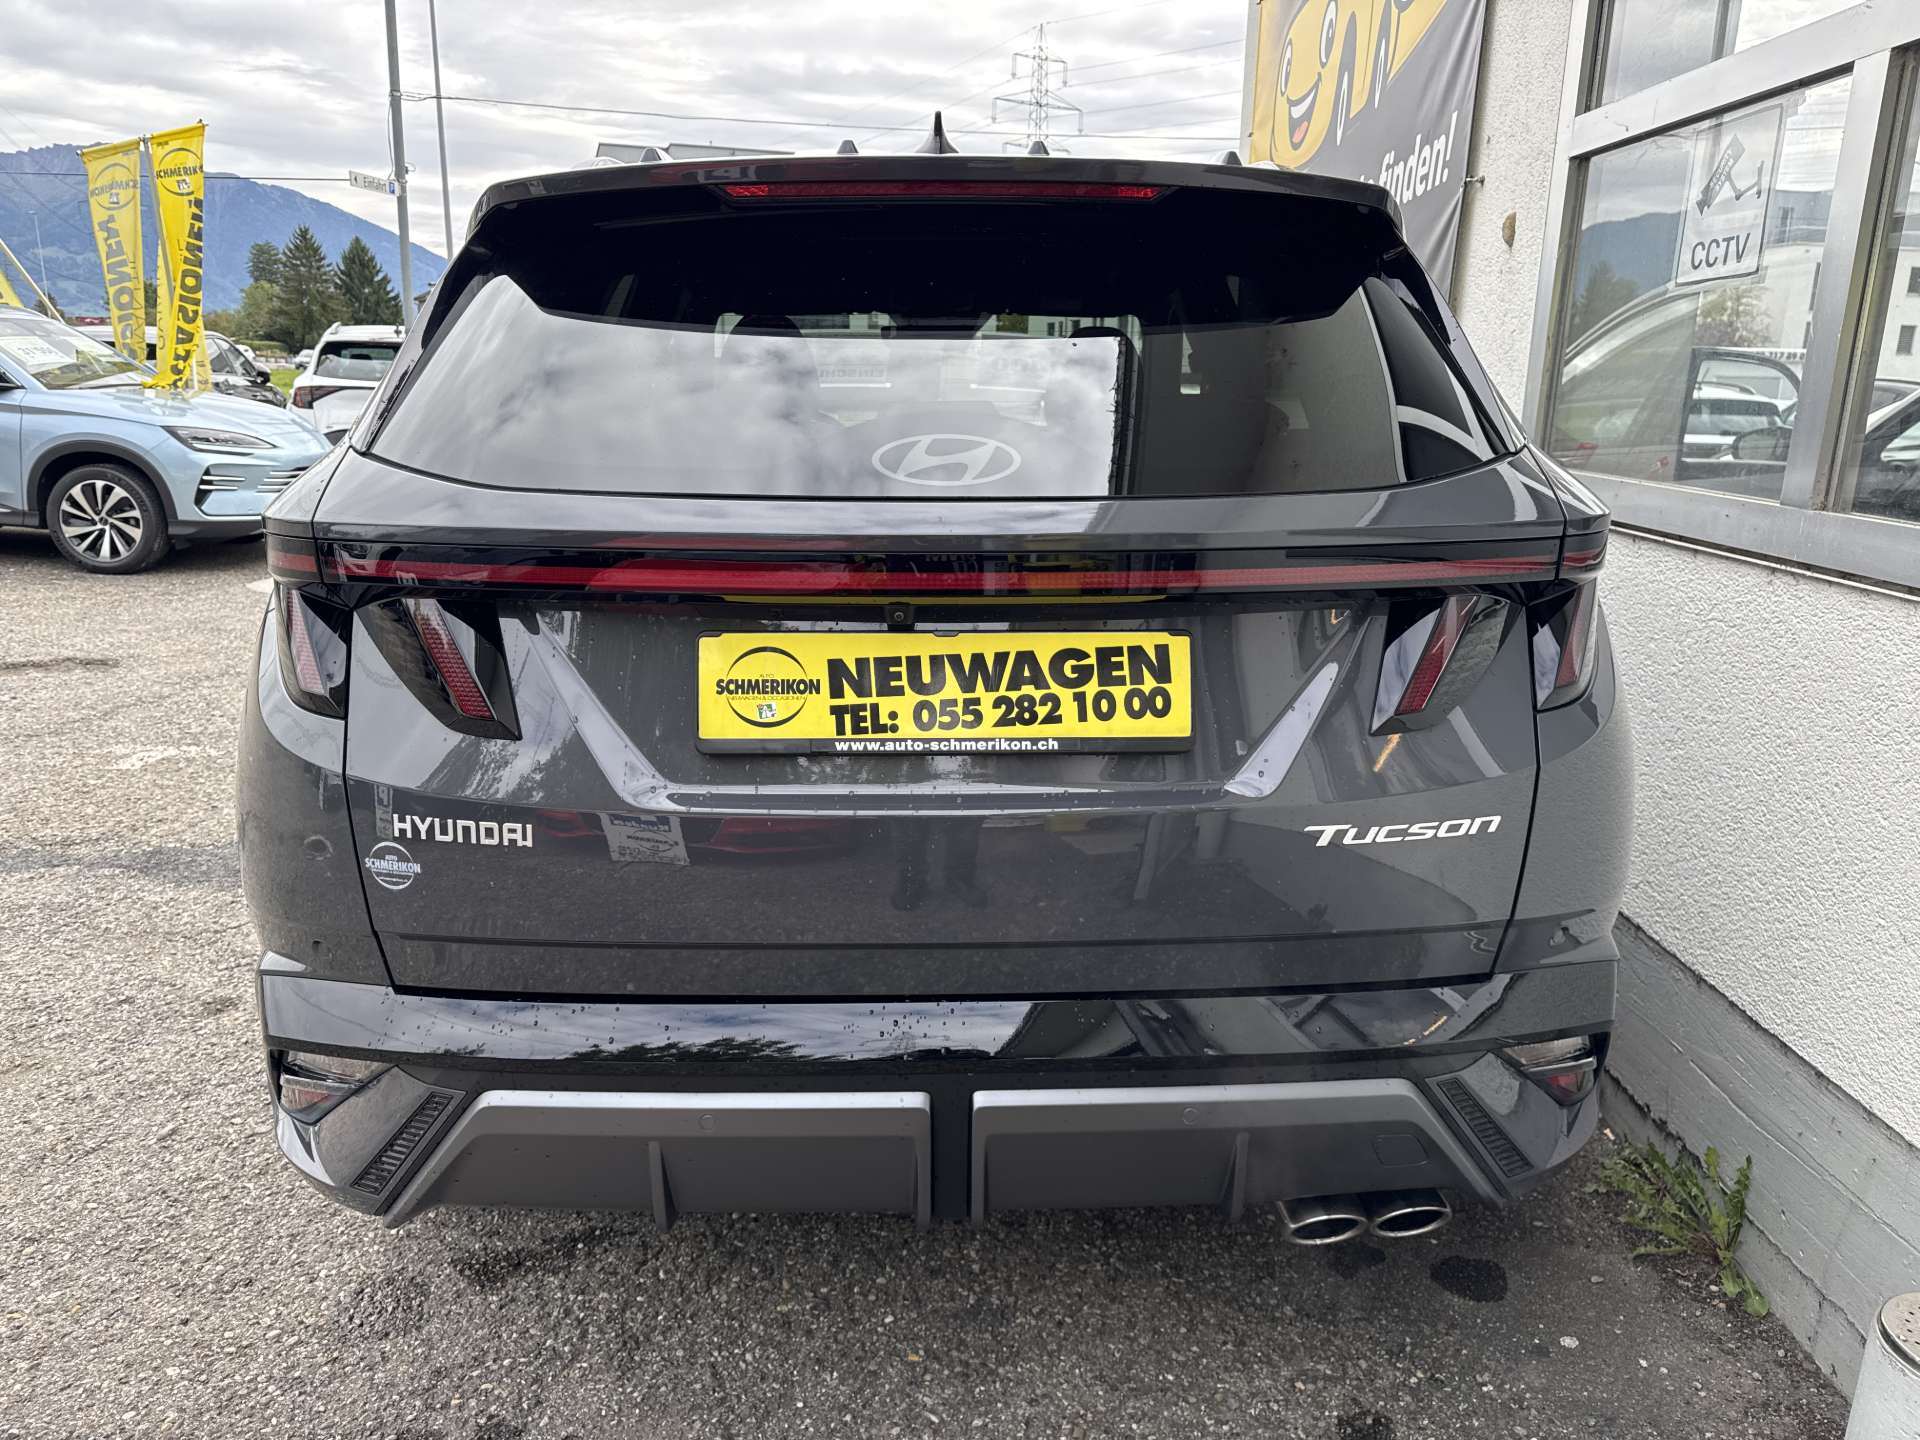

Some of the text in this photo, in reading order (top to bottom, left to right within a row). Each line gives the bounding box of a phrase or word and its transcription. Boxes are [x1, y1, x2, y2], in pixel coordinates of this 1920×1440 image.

[1379, 110, 1458, 205] finden!
[1690, 232, 1751, 270] CCTV
[716, 678, 821, 695] SCHMERIKON
[827, 643, 1173, 699] NEUWAGEN
[830, 686, 1173, 737] TEL: 055 282 10 00
[834, 738, 1059, 752] www.auto-schmerikon.ch
[392, 813, 534, 848] HYUNDAI
[364, 857, 422, 874] SCHMERIKON
